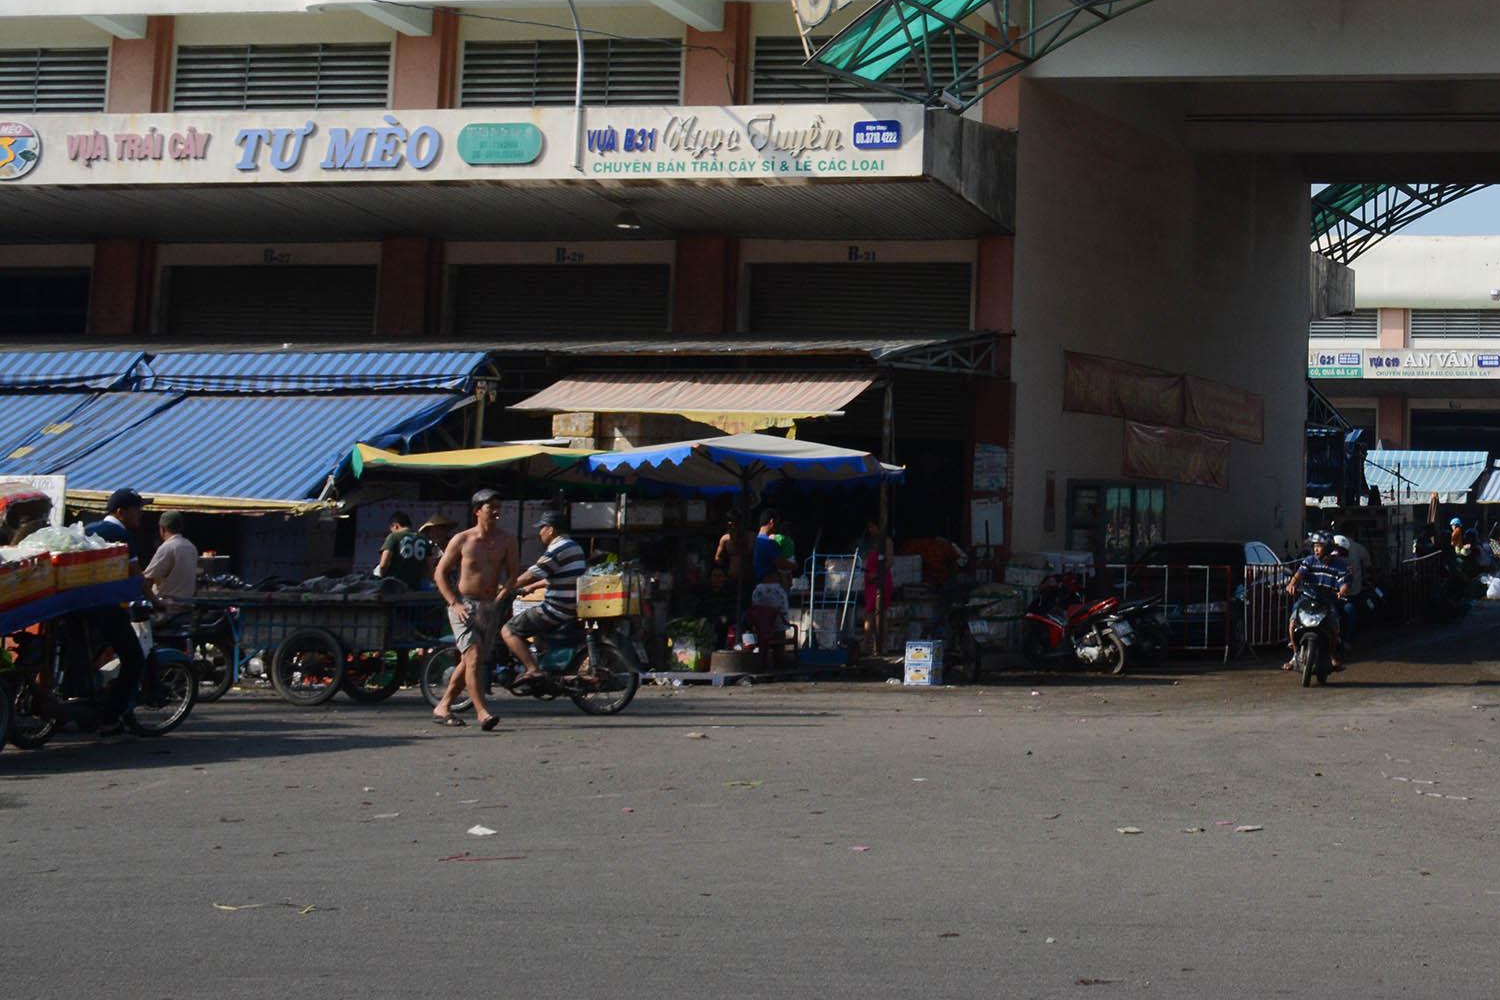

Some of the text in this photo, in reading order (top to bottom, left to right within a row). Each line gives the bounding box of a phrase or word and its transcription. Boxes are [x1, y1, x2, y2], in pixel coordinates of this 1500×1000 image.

[66, 129, 108, 168] VỰA
[114, 126, 164, 160] TRÁI
[168, 126, 212, 160] CÂY
[235, 119, 316, 171] TƯ
[320, 114, 443, 171] MÈO
[623, 128, 658, 152] B31
[593, 158, 651, 173] CHUYÊN
[656, 158, 686, 173] BÁN
[691, 158, 723, 172] TRÁI
[728, 157, 756, 172] CÂY
[780, 160, 790, 172] &
[817, 157, 848, 172] CÁC
[852, 159, 885, 173] LOẠI
[1404, 352, 1432, 368] AN
[1435, 350, 1475, 368] VÂN
